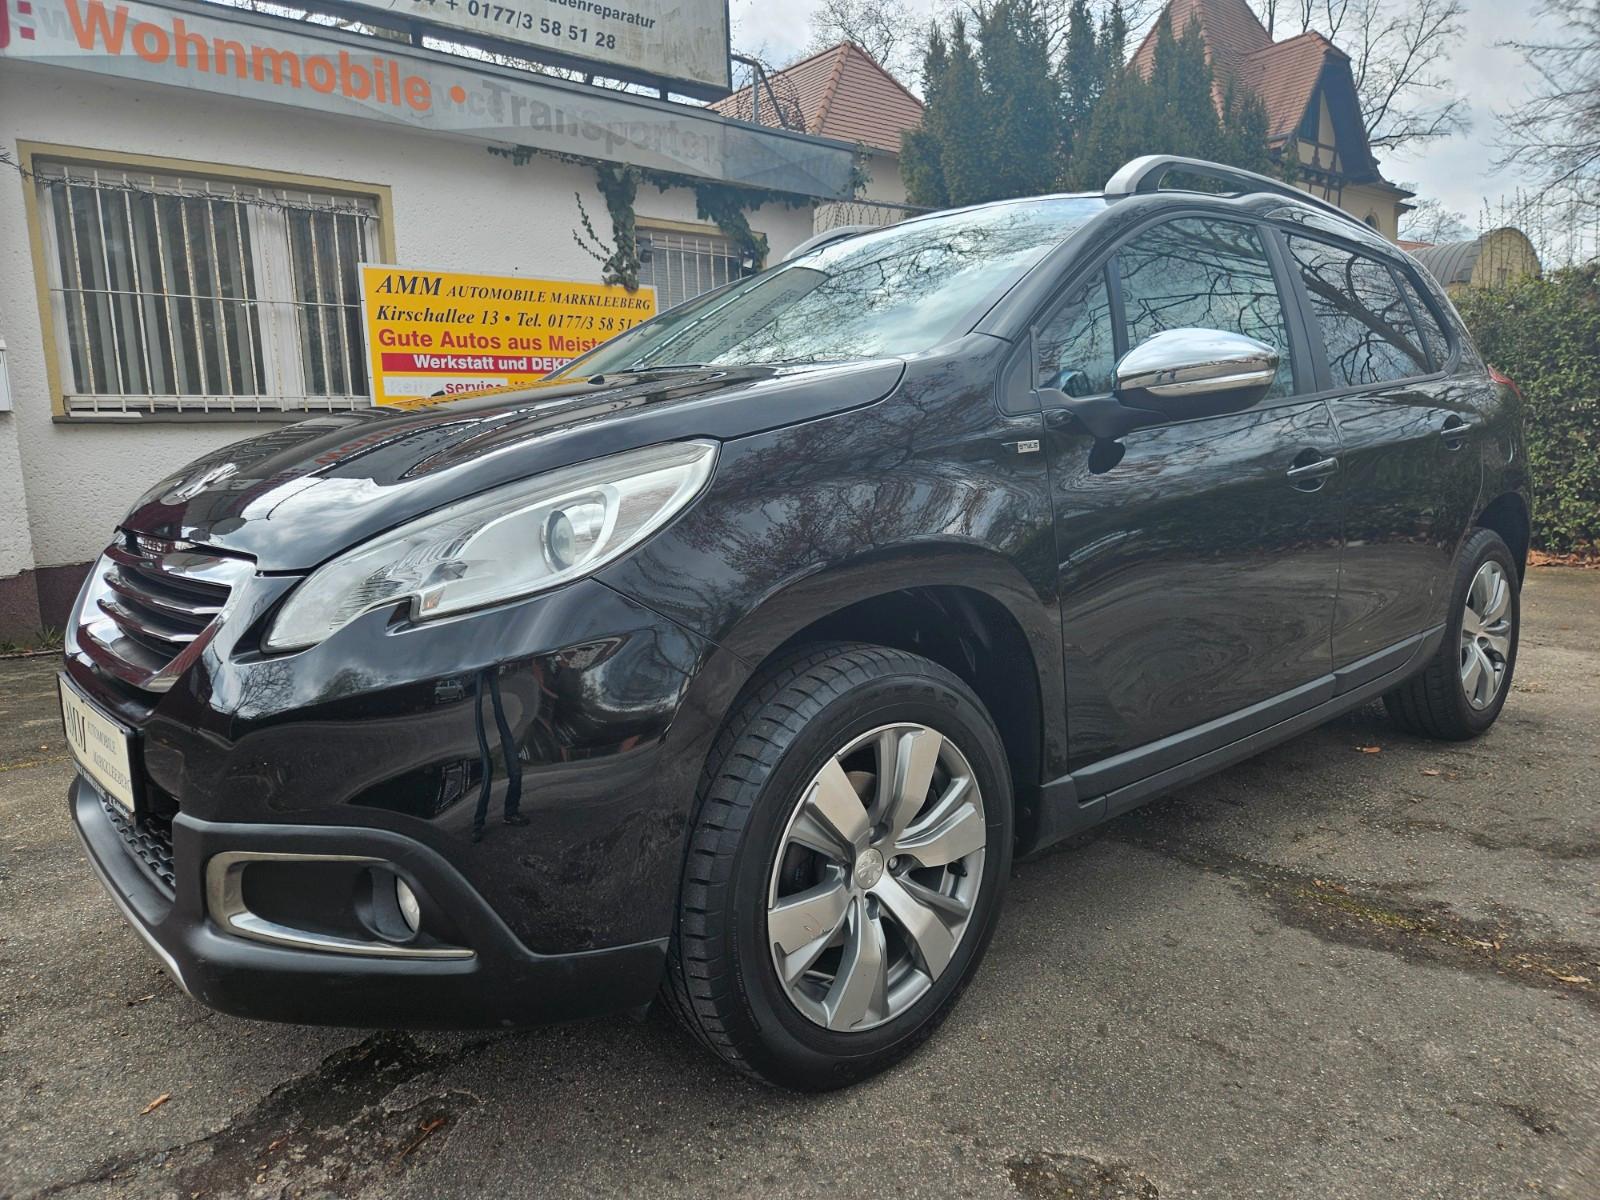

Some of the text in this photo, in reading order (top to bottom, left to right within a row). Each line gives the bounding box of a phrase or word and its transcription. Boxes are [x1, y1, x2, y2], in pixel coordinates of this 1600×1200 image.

[540, 18, 562, 37] 58
[568, 25, 588, 43] 51
[595, 32, 616, 50] 28
[64, 0, 432, 112] Wohnmobile
[375, 274, 651, 311] AMM AUTOMOBILE MARKKLEEBERG
[376, 305, 475, 325] Kirschallee
[481, 310, 499, 326] 13
[517, 312, 542, 328] Tel.
[547, 313, 594, 330] 0177/3
[598, 317, 615, 331] 58
[378, 328, 604, 352] Gute Autos aus Meist
[413, 354, 495, 371] Werkstatt
[498, 357, 528, 371] und
